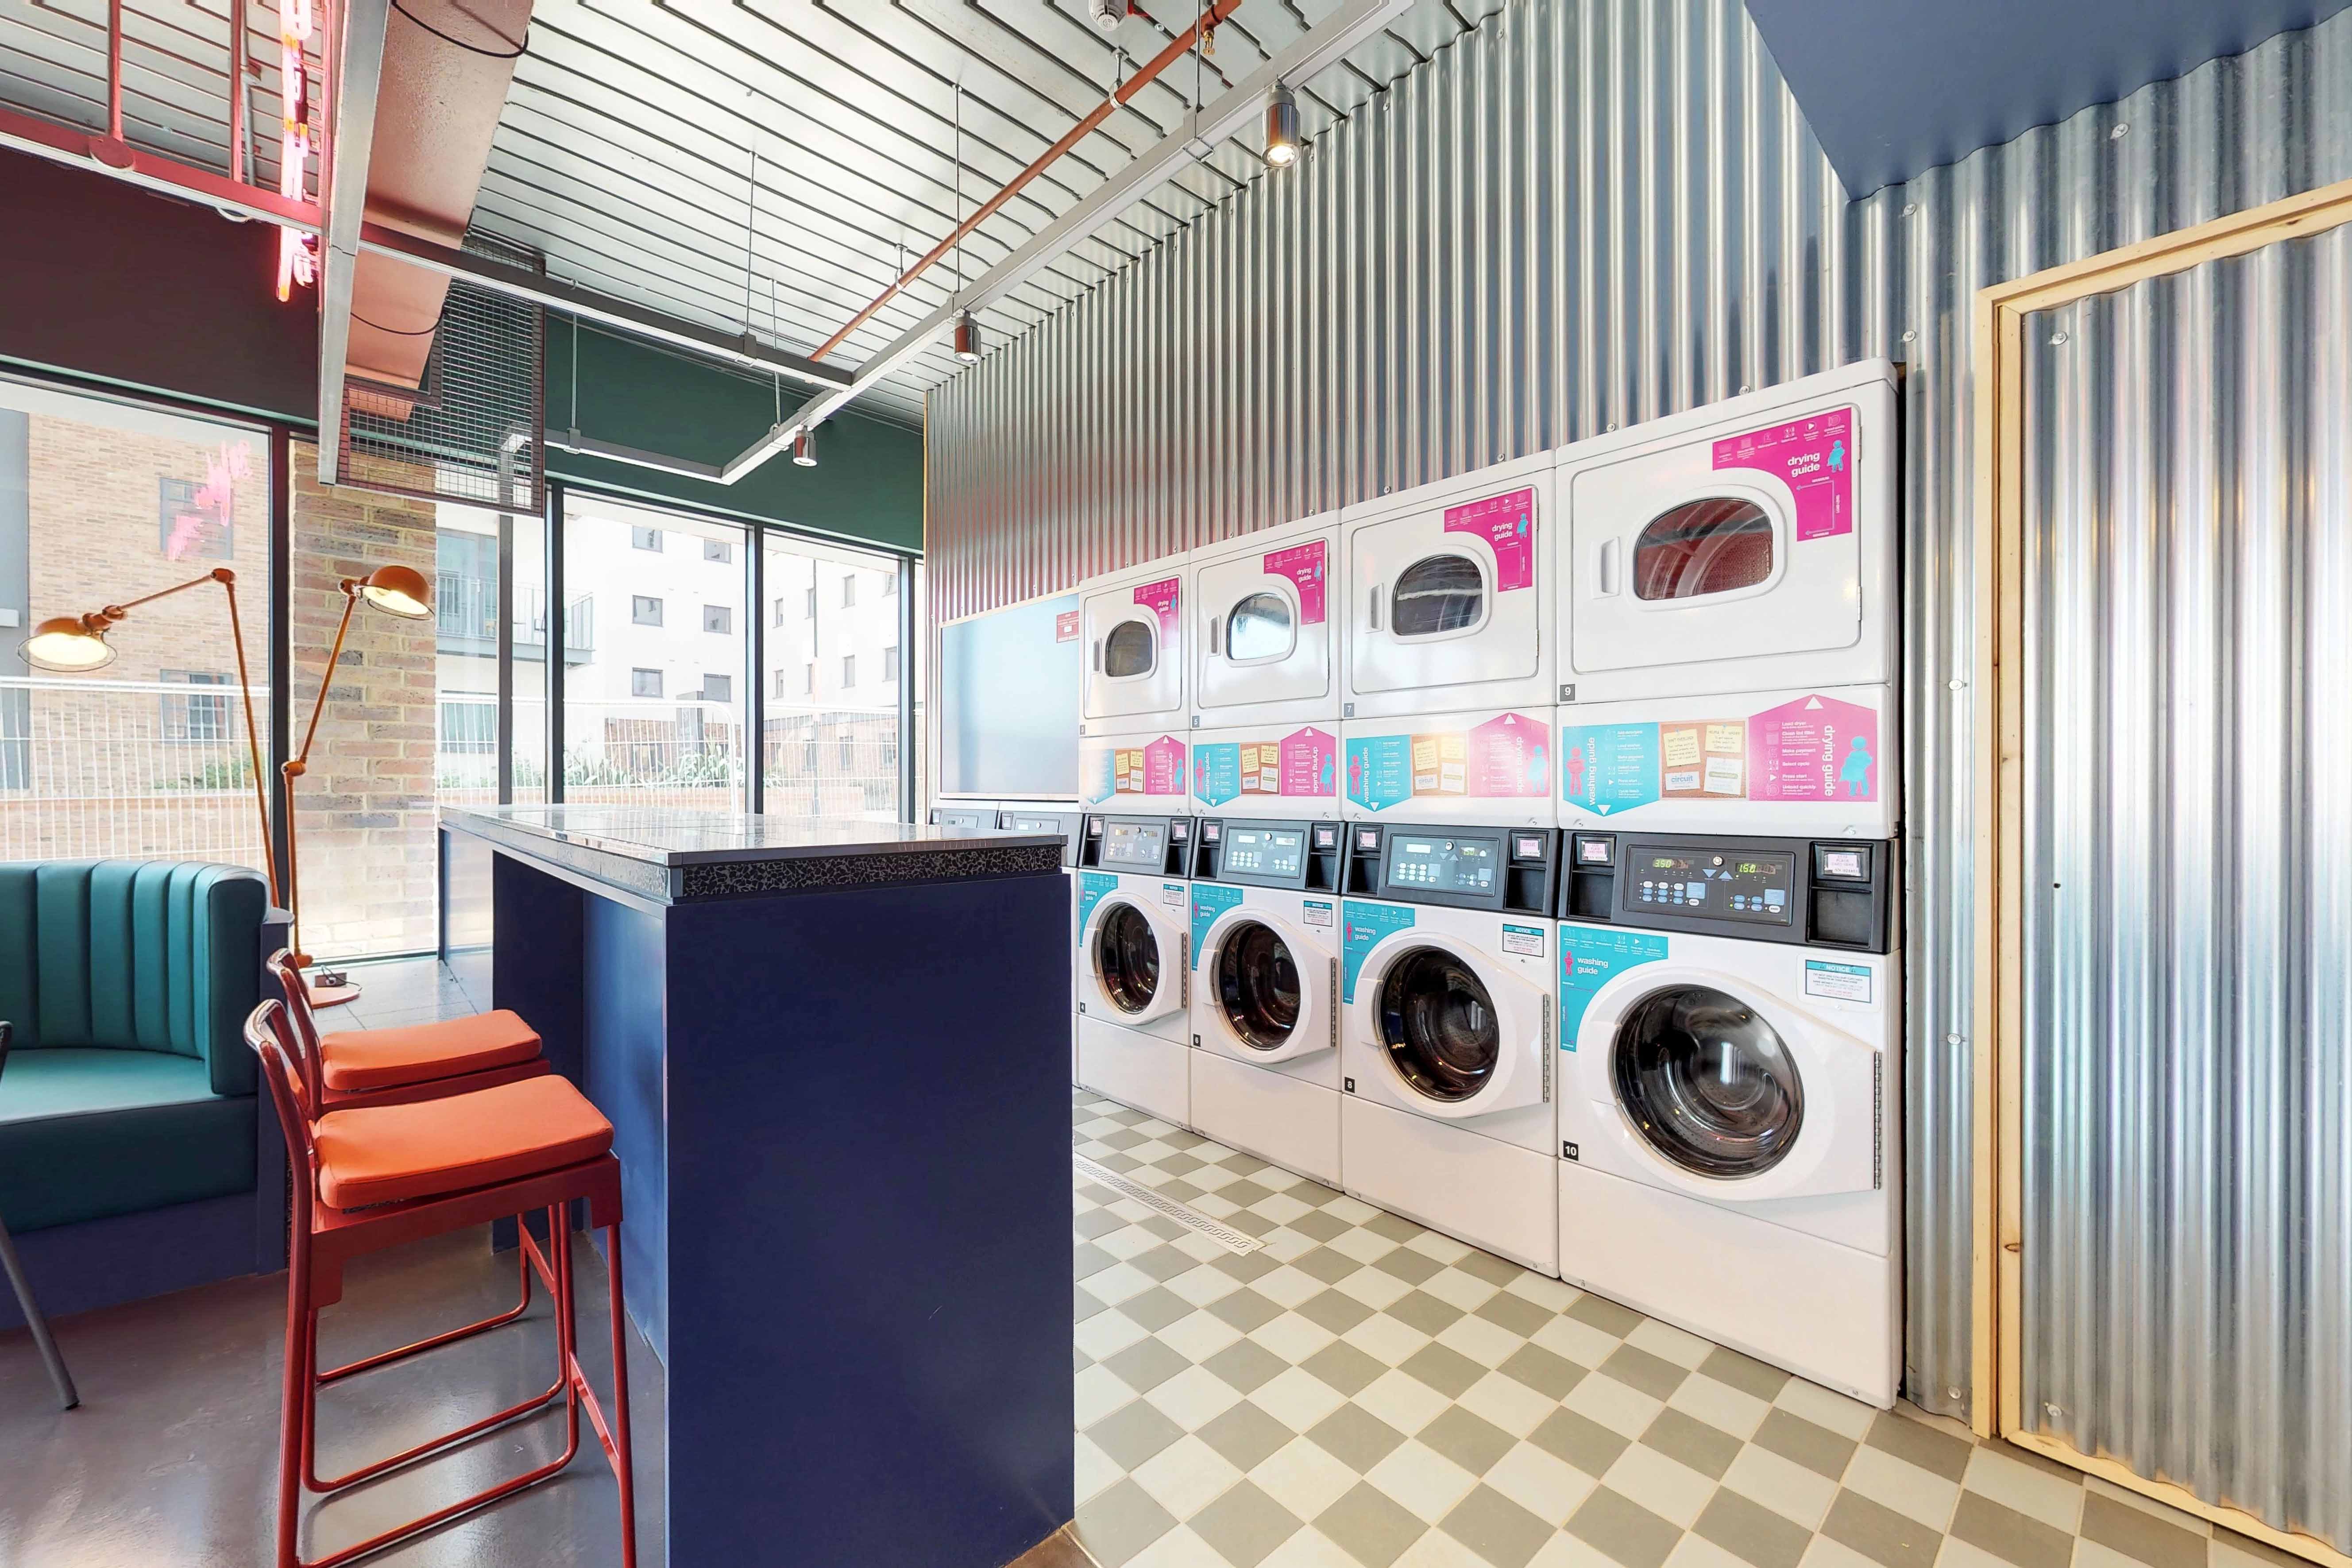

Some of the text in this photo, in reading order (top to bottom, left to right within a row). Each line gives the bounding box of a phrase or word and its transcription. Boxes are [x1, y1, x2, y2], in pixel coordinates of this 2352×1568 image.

[1788, 452, 1820, 467] drying
[1792, 464, 1820, 477] guide
[1492, 522, 1513, 533] drying
[1494, 530, 1513, 541] guide
[1298, 575, 1312, 583] guide
[1564, 687, 1571, 695] 9
[1822, 725, 1836, 796] drying guide
[1587, 737, 1597, 806] washing guide
[1355, 927, 1376, 935] washing
[1577, 957, 1608, 968] washing
[1565, 1146, 1577, 1156] 10
